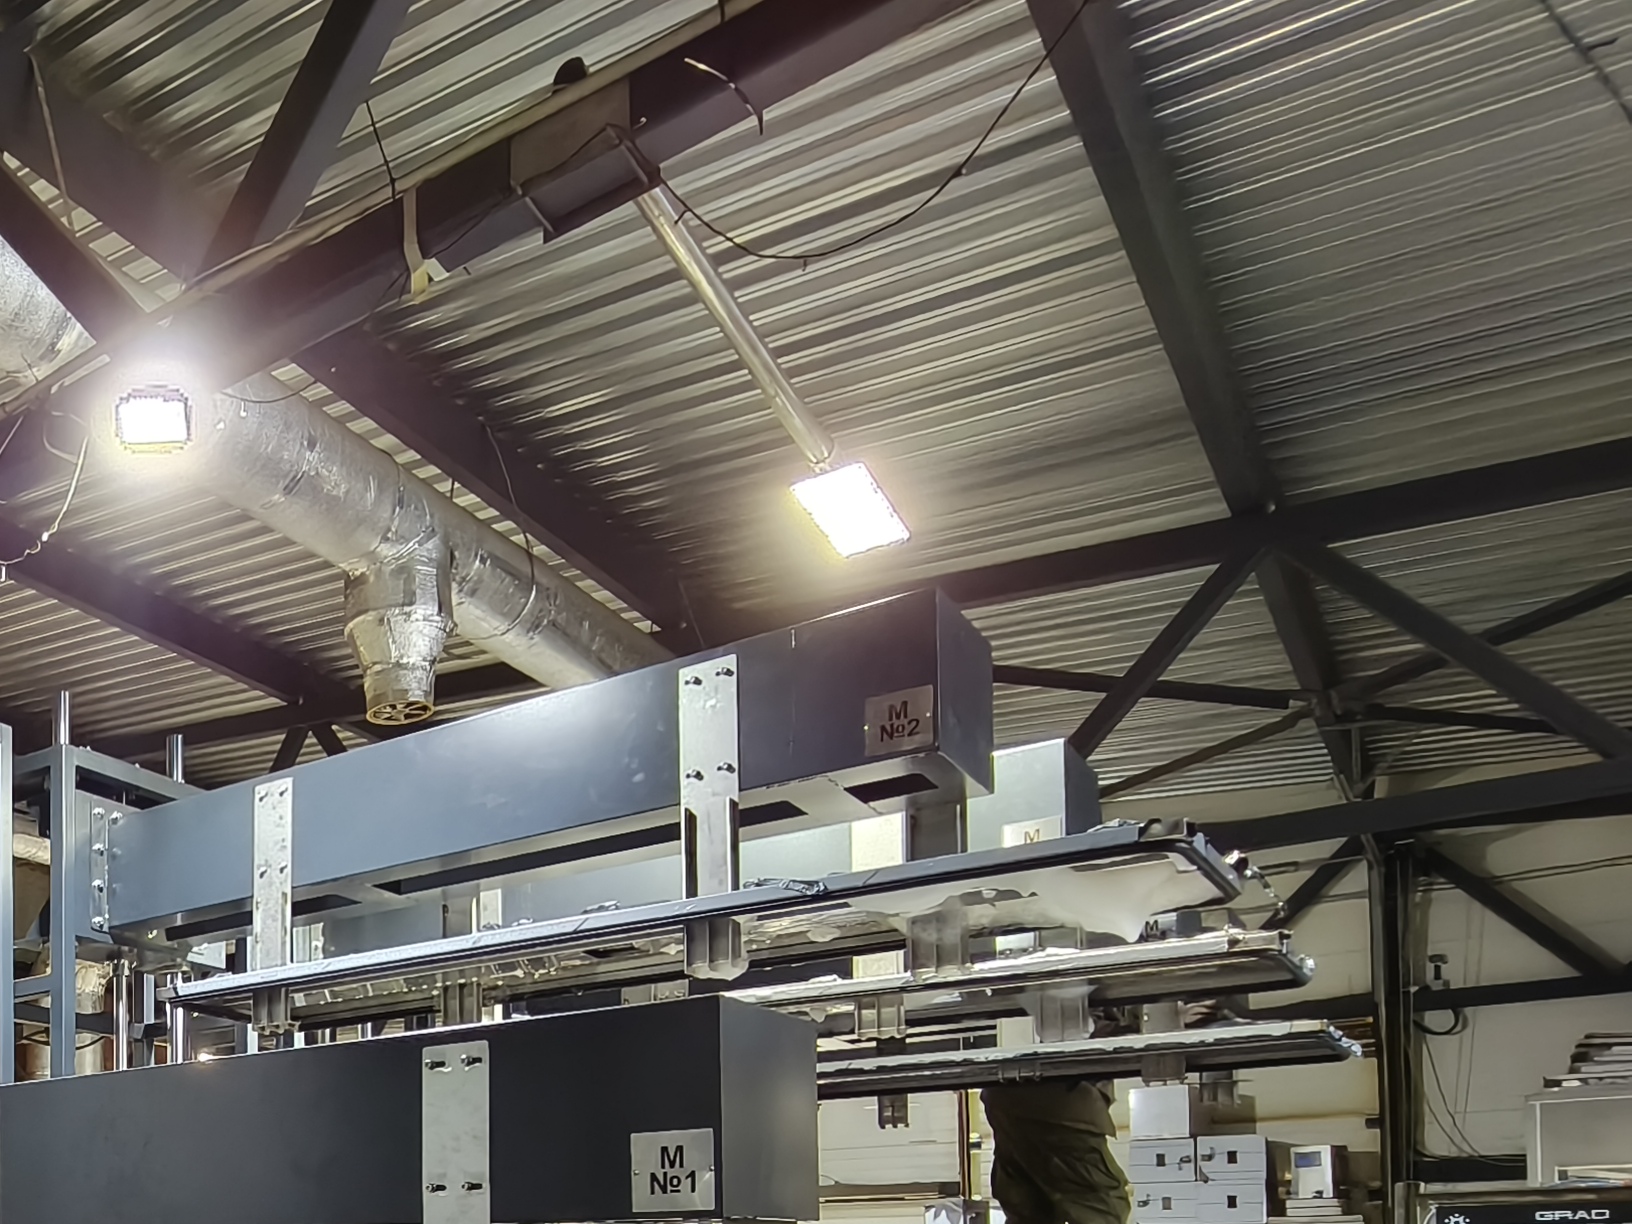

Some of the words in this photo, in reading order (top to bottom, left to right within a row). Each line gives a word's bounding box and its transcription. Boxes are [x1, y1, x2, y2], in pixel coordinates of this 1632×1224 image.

[888, 700, 908, 722] M
[1024, 828, 1040, 844] M
[660, 1145, 685, 1169] M
[649, 1170, 697, 1195] №1
[1534, 1209, 1610, 1221] GRAD
